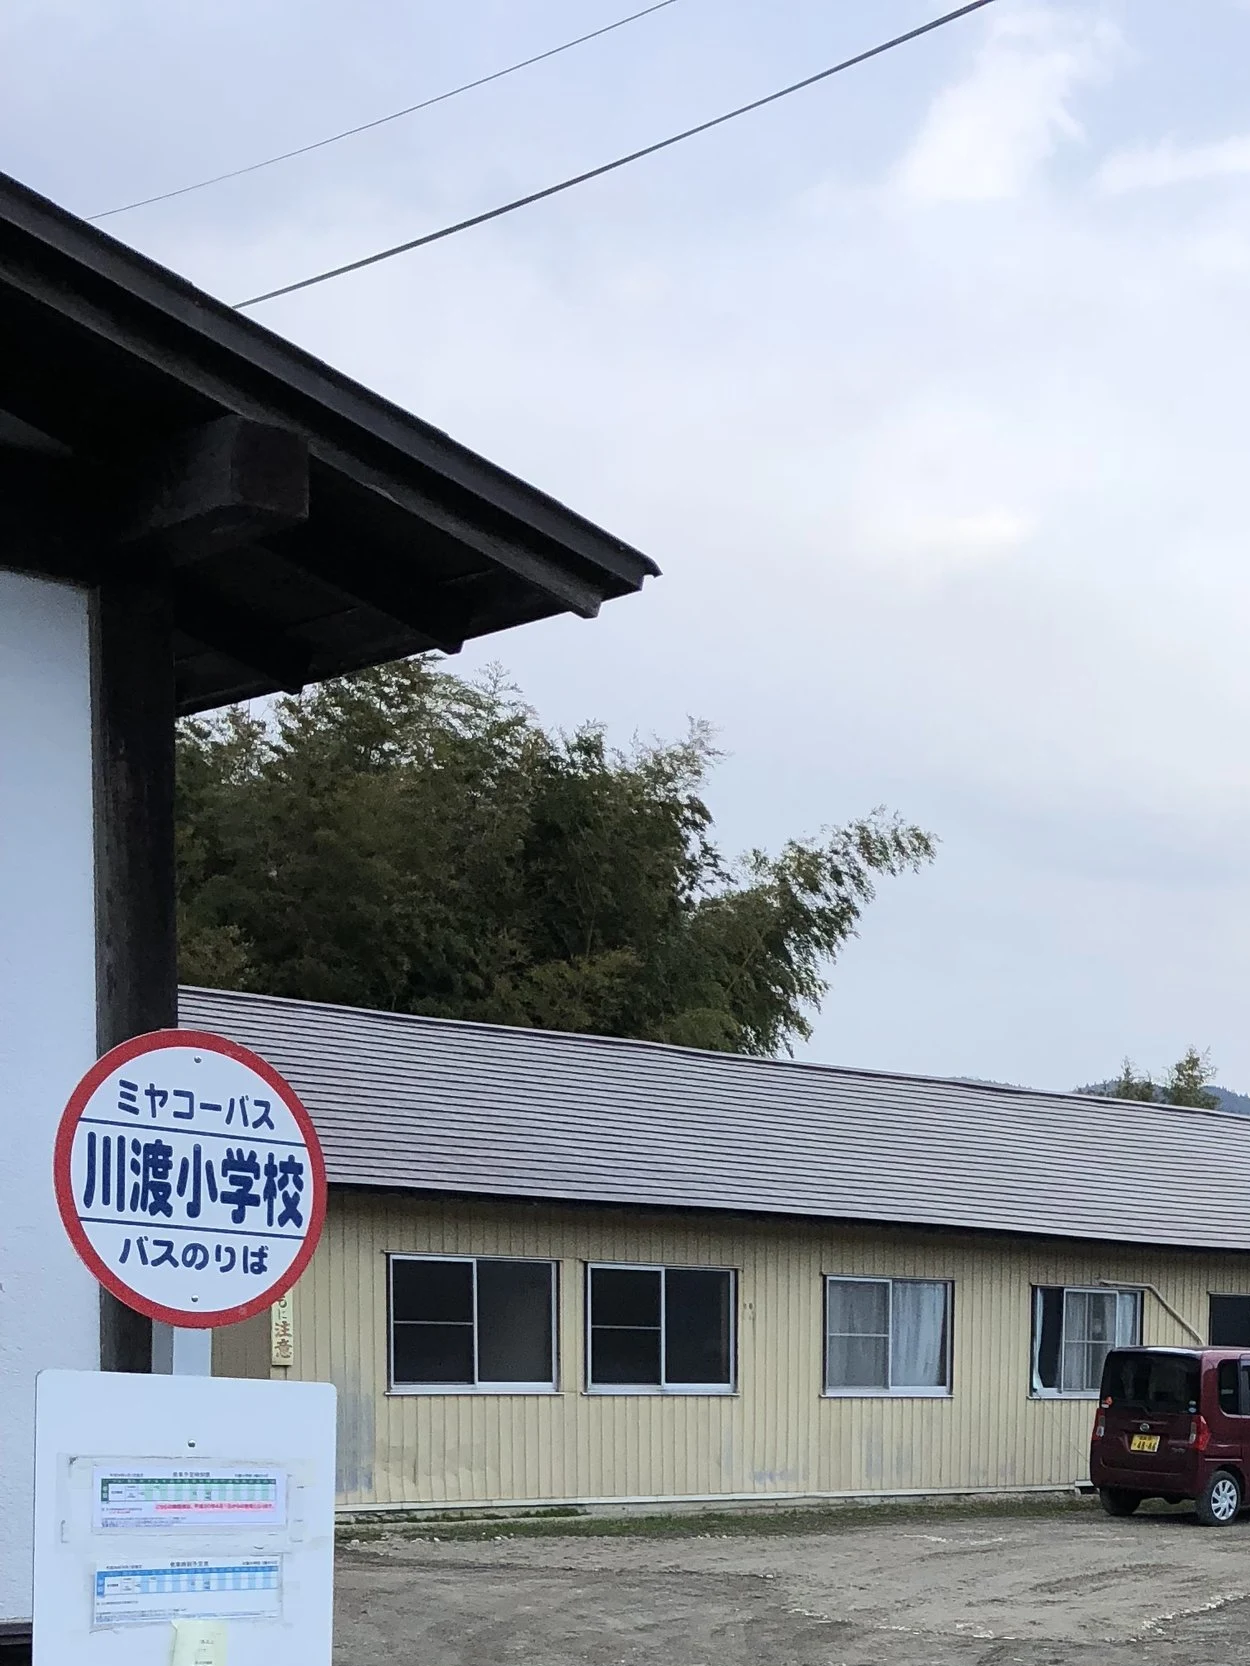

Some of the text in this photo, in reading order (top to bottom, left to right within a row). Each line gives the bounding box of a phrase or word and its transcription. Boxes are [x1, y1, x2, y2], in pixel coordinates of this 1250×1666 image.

[117, 1079, 275, 1130] ミヤコーバス
[83, 1131, 304, 1229] 川渡小学校
[118, 1235, 269, 1275] バスのりば
